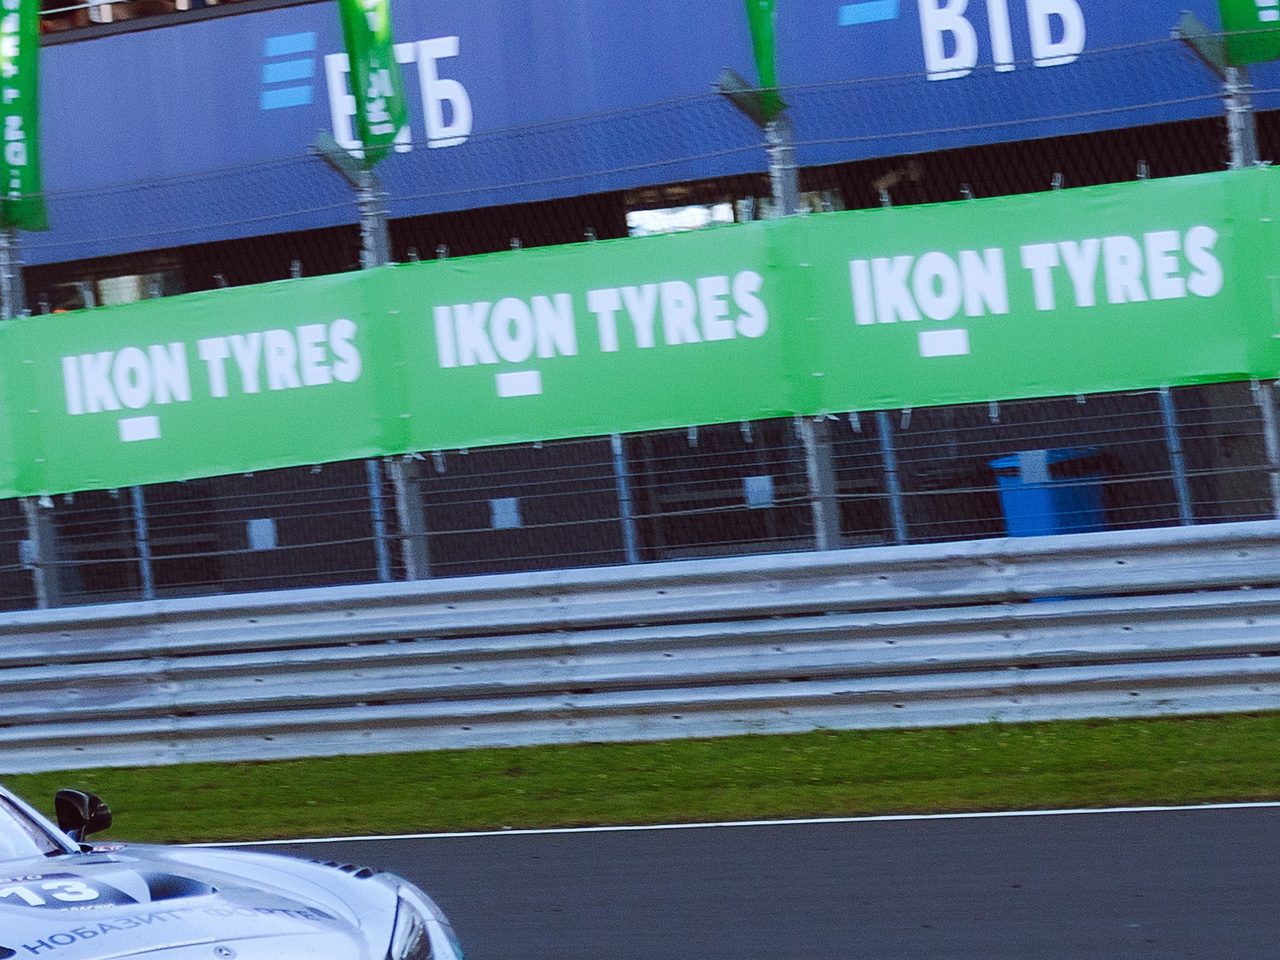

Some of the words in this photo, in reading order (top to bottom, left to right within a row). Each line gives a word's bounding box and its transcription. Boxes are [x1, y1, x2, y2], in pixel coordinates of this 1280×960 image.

[433, 293, 578, 368] IKON
[586, 270, 768, 353] TYRES
[850, 248, 1009, 325] IKON
[1020, 225, 1223, 311] TYRES
[62, 342, 191, 415] IKON
[198, 319, 361, 398] TYRES
